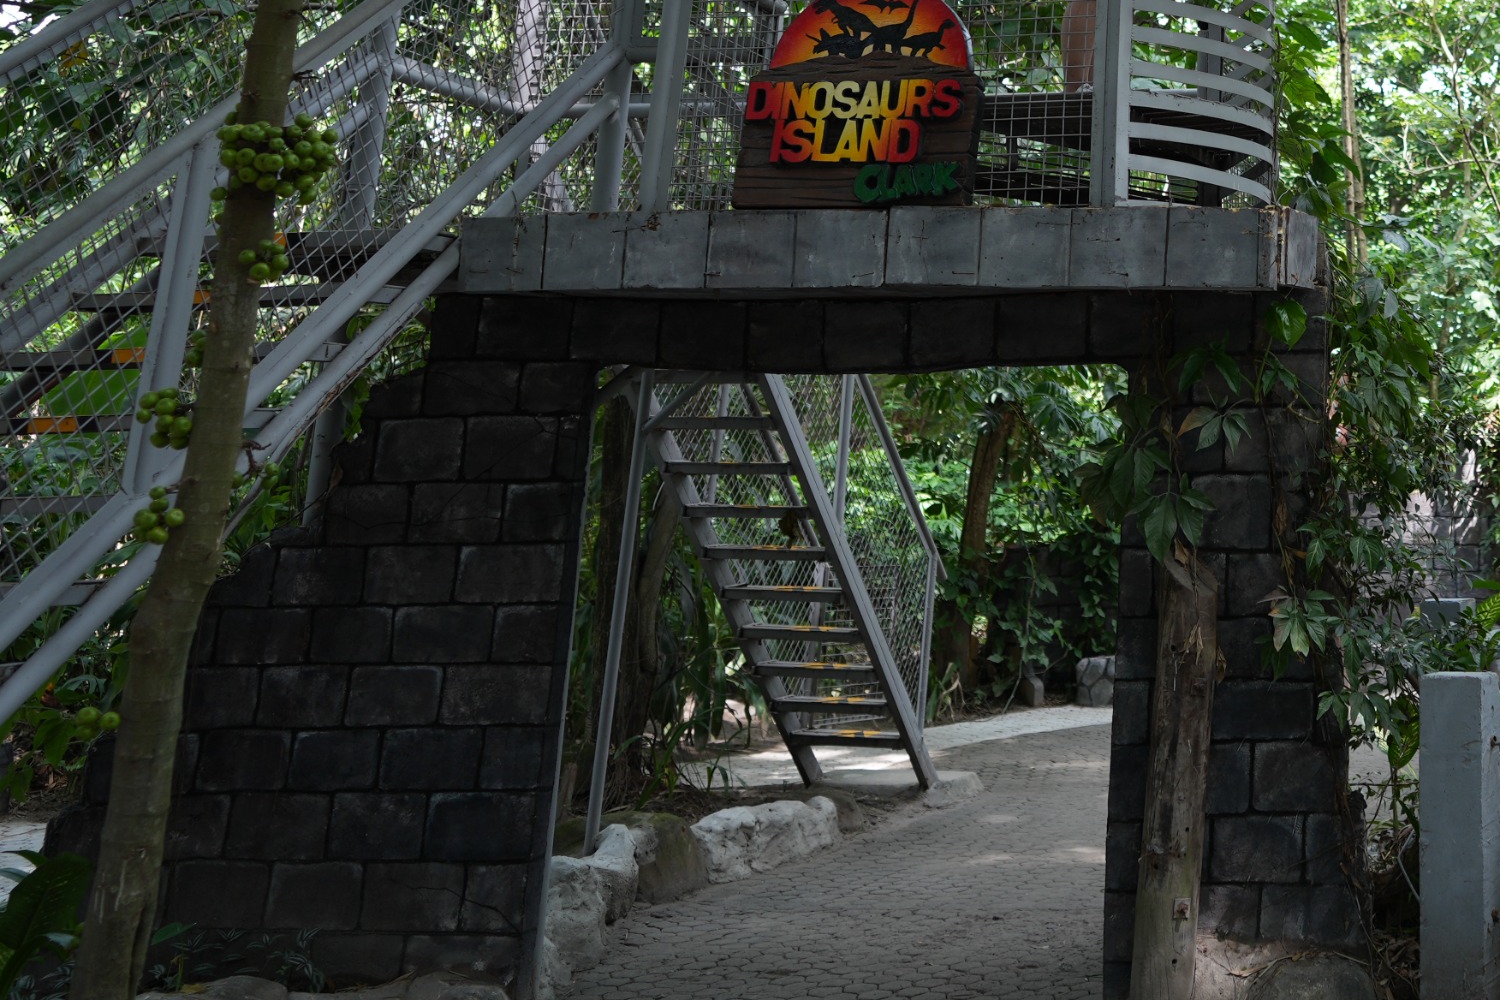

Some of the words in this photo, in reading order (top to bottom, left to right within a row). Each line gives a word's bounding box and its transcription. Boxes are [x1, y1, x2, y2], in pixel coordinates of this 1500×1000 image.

[745, 78, 961, 120] DINOSAURS
[769, 118, 920, 163] ISLAND
[853, 161, 960, 203] CLARK
